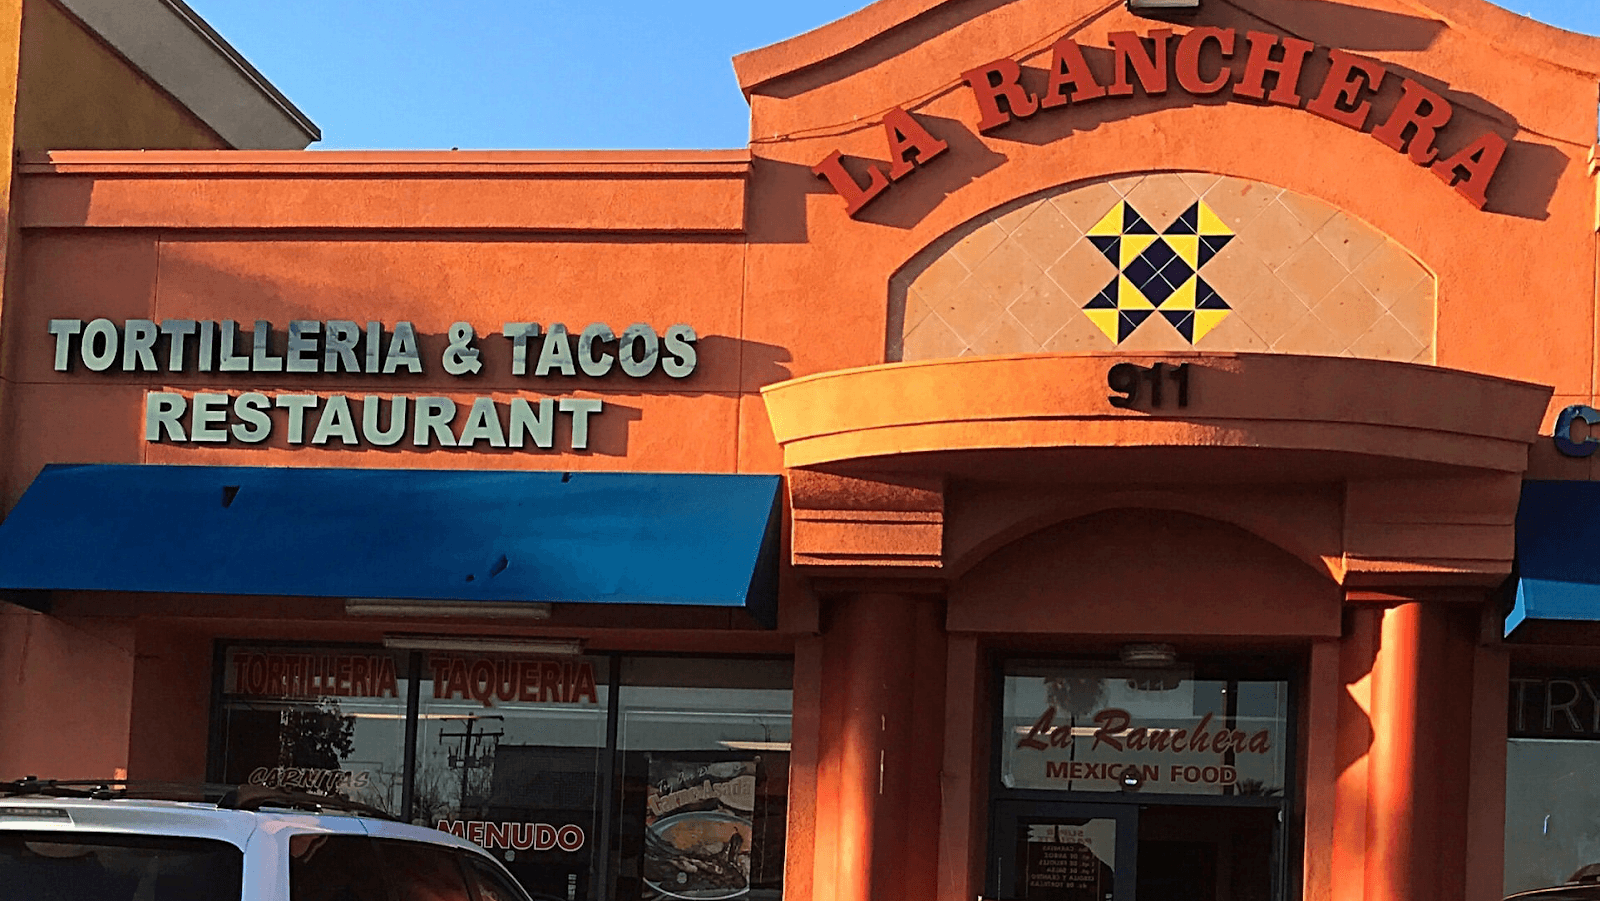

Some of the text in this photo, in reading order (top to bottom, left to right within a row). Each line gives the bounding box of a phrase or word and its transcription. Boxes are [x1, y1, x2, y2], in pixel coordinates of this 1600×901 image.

[812, 26, 1508, 219] LA RANCHERA
[49, 318, 697, 378] TORTILLERIA & TACOS
[1107, 361, 1189, 409] 911
[145, 391, 602, 449] RESTAURANT
[232, 652, 400, 698] TORTILLERIA
[428, 656, 598, 707] TAQUERIA
[1017, 706, 1272, 754] La Ranchera
[247, 766, 370, 790] CARNITAS
[1046, 761, 1237, 784] MEXICN FOOD
[648, 778, 754, 816] Carne Asada
